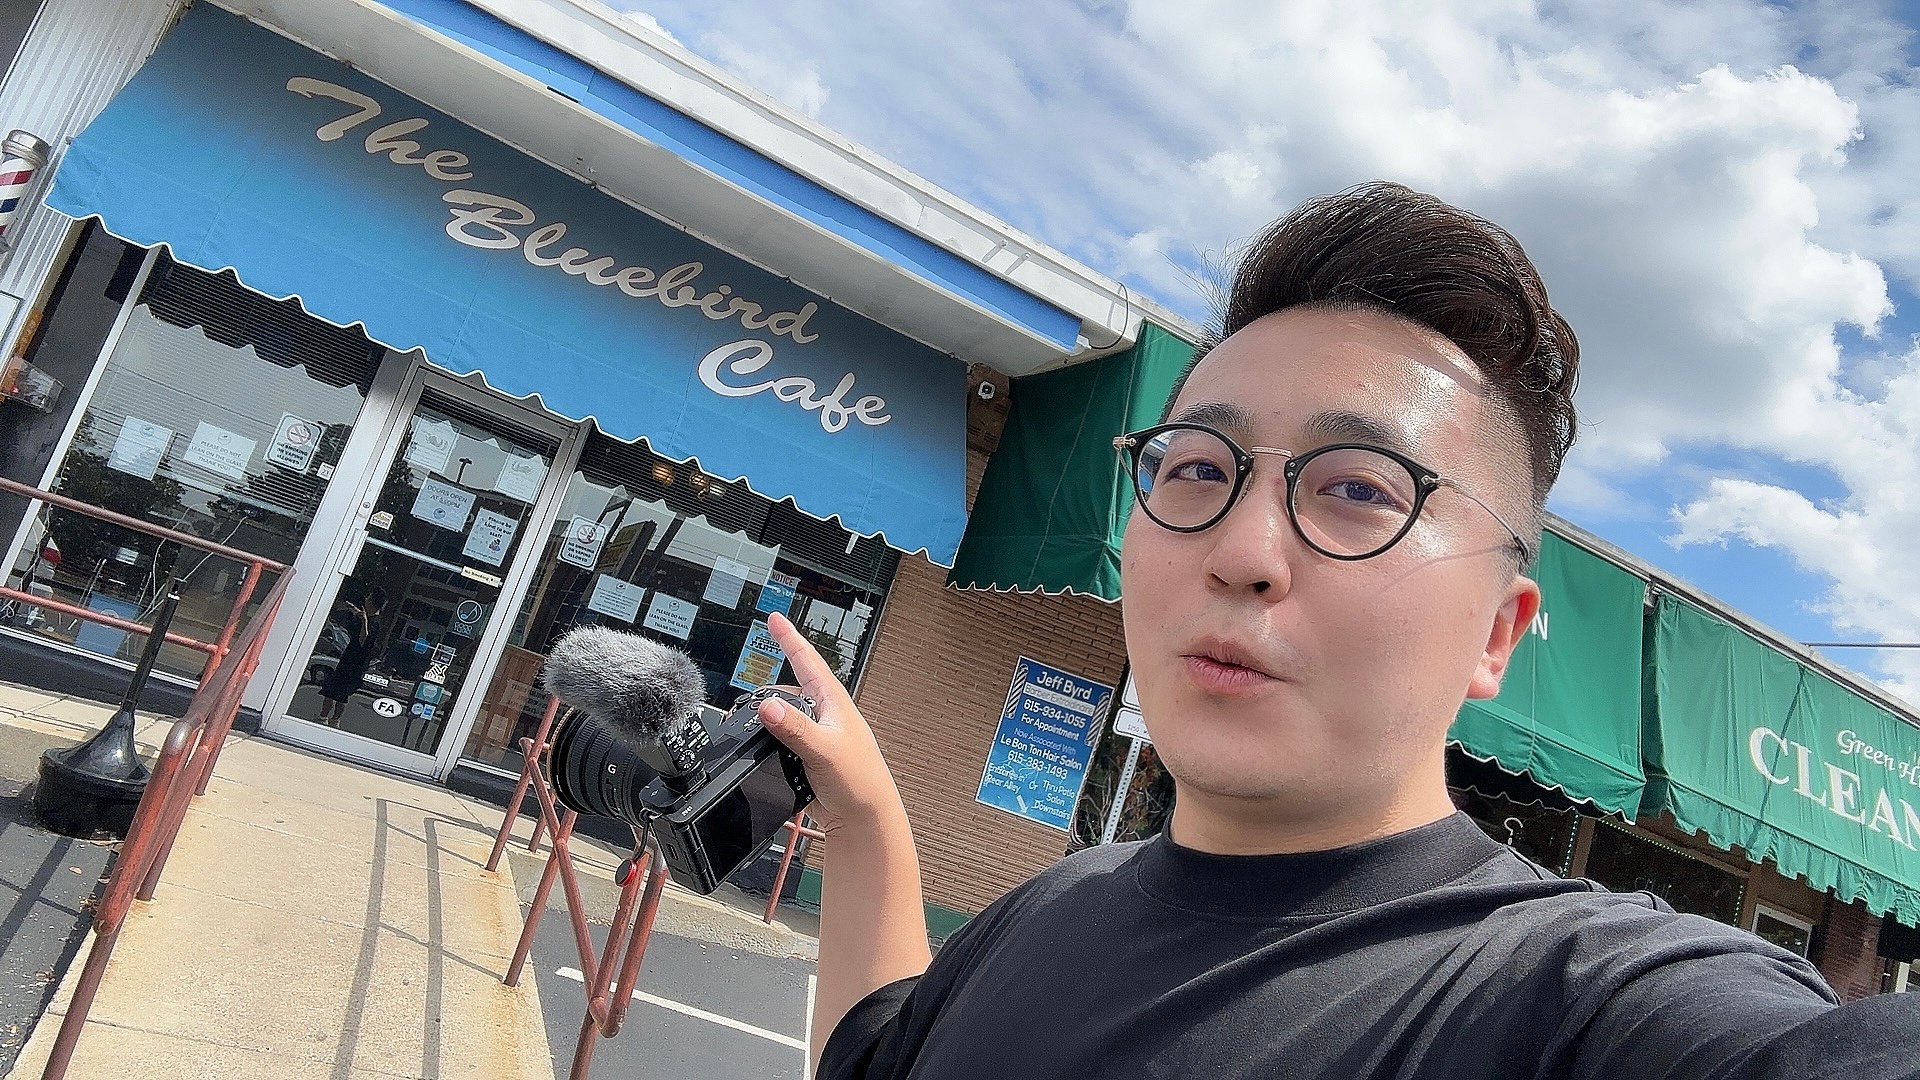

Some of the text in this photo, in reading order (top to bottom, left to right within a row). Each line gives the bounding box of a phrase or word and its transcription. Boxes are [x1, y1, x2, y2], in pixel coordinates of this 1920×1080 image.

[286, 76, 473, 181] The
[442, 189, 819, 344] Bluebird
[698, 339, 892, 433] Cafe
[192, 445, 204, 453] LEAN
[201, 440, 219, 450] PLEASE
[230, 450, 241, 458] NOT
[285, 444, 308, 456] SMOKING
[285, 450, 303, 460] VAPING
[198, 456, 216, 466] THANK
[427, 484, 467, 503] DOORS OPEN
[488, 516, 505, 526] Please
[575, 544, 595, 553] SMOKING
[575, 549, 591, 558] VAPING
[568, 552, 587, 562] ALLOWED
[471, 571, 489, 581] Smoking
[770, 569, 795, 586] NOTICE
[656, 608, 670, 617] PLEASE
[655, 621, 668, 630] THANK
[750, 640, 782, 654] PARTY
[1025, 684, 1051, 699] Barber
[1036, 671, 1092, 700] Jeff Byrd
[378, 702, 395, 714] FA
[1023, 699, 1086, 728] 615-934-1055
[1021, 713, 1080, 741] For Appointment
[1014, 727, 1076, 755] Now Associated With
[1000, 733, 1082, 771] Le Bon Ton Hair Salon
[1838, 729, 1896, 771] Green
[608, 763, 617, 774] G
[988, 763, 1018, 780] Entrance
[1008, 750, 1068, 780] 615-383-1493
[986, 774, 1021, 794] Rear Alley
[1028, 780, 1038, 791] Or
[1042, 780, 1075, 798] Thru Patio
[1046, 793, 1065, 806] Salon
[1033, 800, 1071, 820] Downstairs
